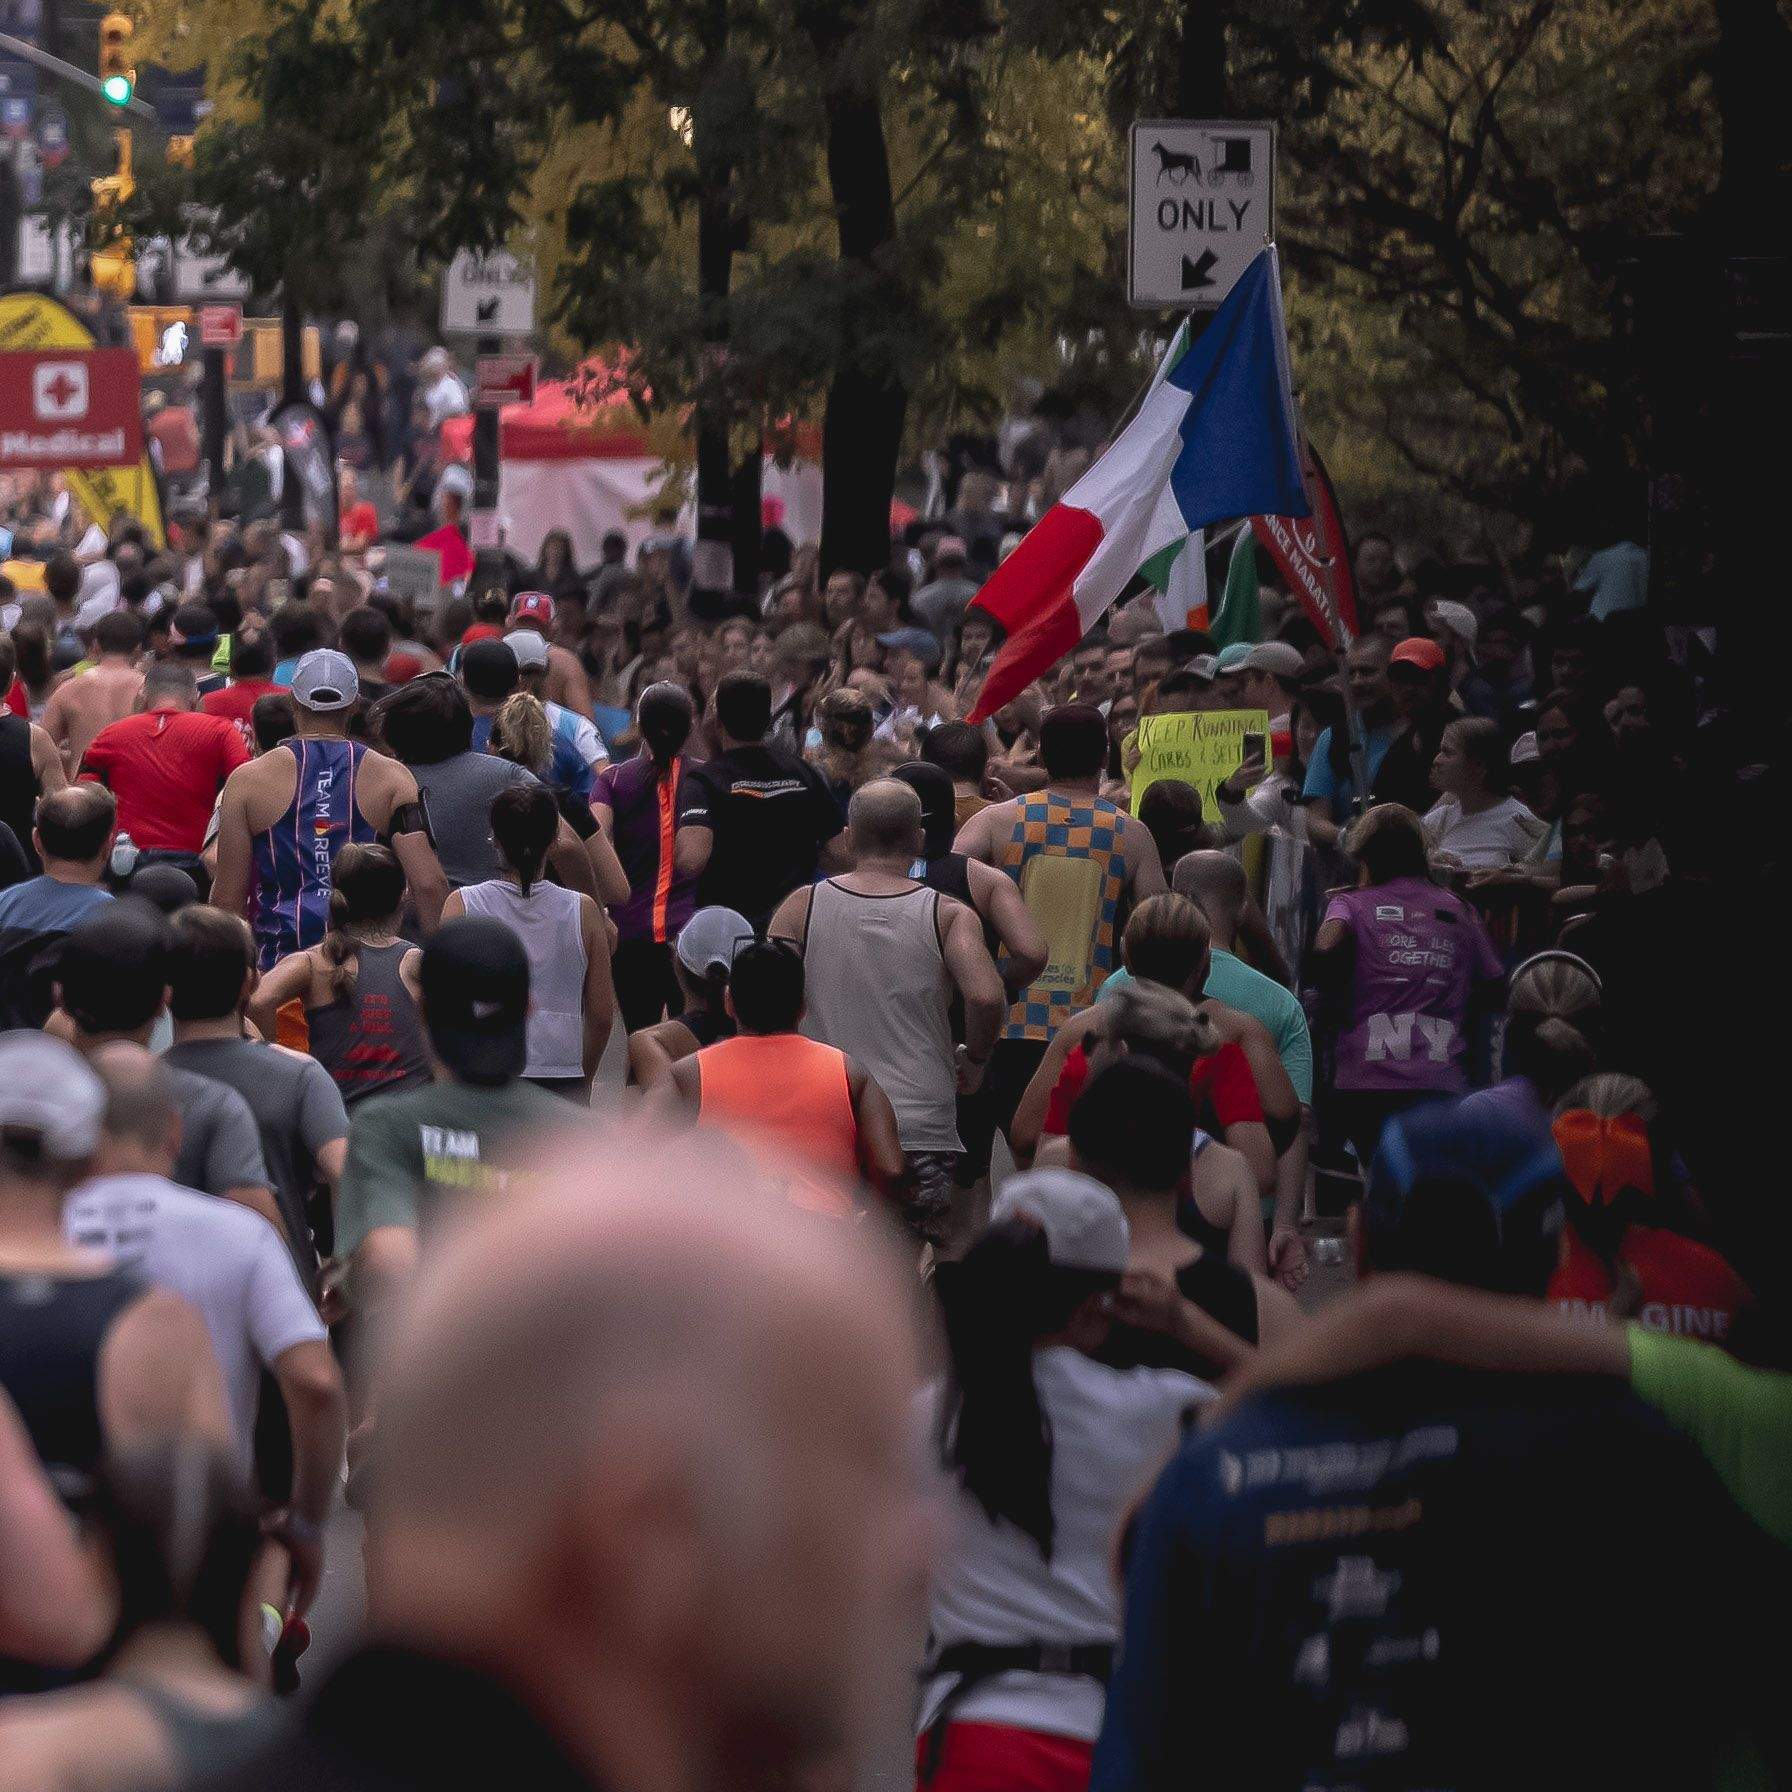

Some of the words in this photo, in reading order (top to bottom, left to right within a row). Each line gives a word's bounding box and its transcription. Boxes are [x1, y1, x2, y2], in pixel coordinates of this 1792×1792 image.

[1158, 199, 1250, 232] ONLY
[315, 766, 334, 818] TEAM
[314, 837, 333, 897] REEVE
[1365, 1012, 1456, 1062] NY
